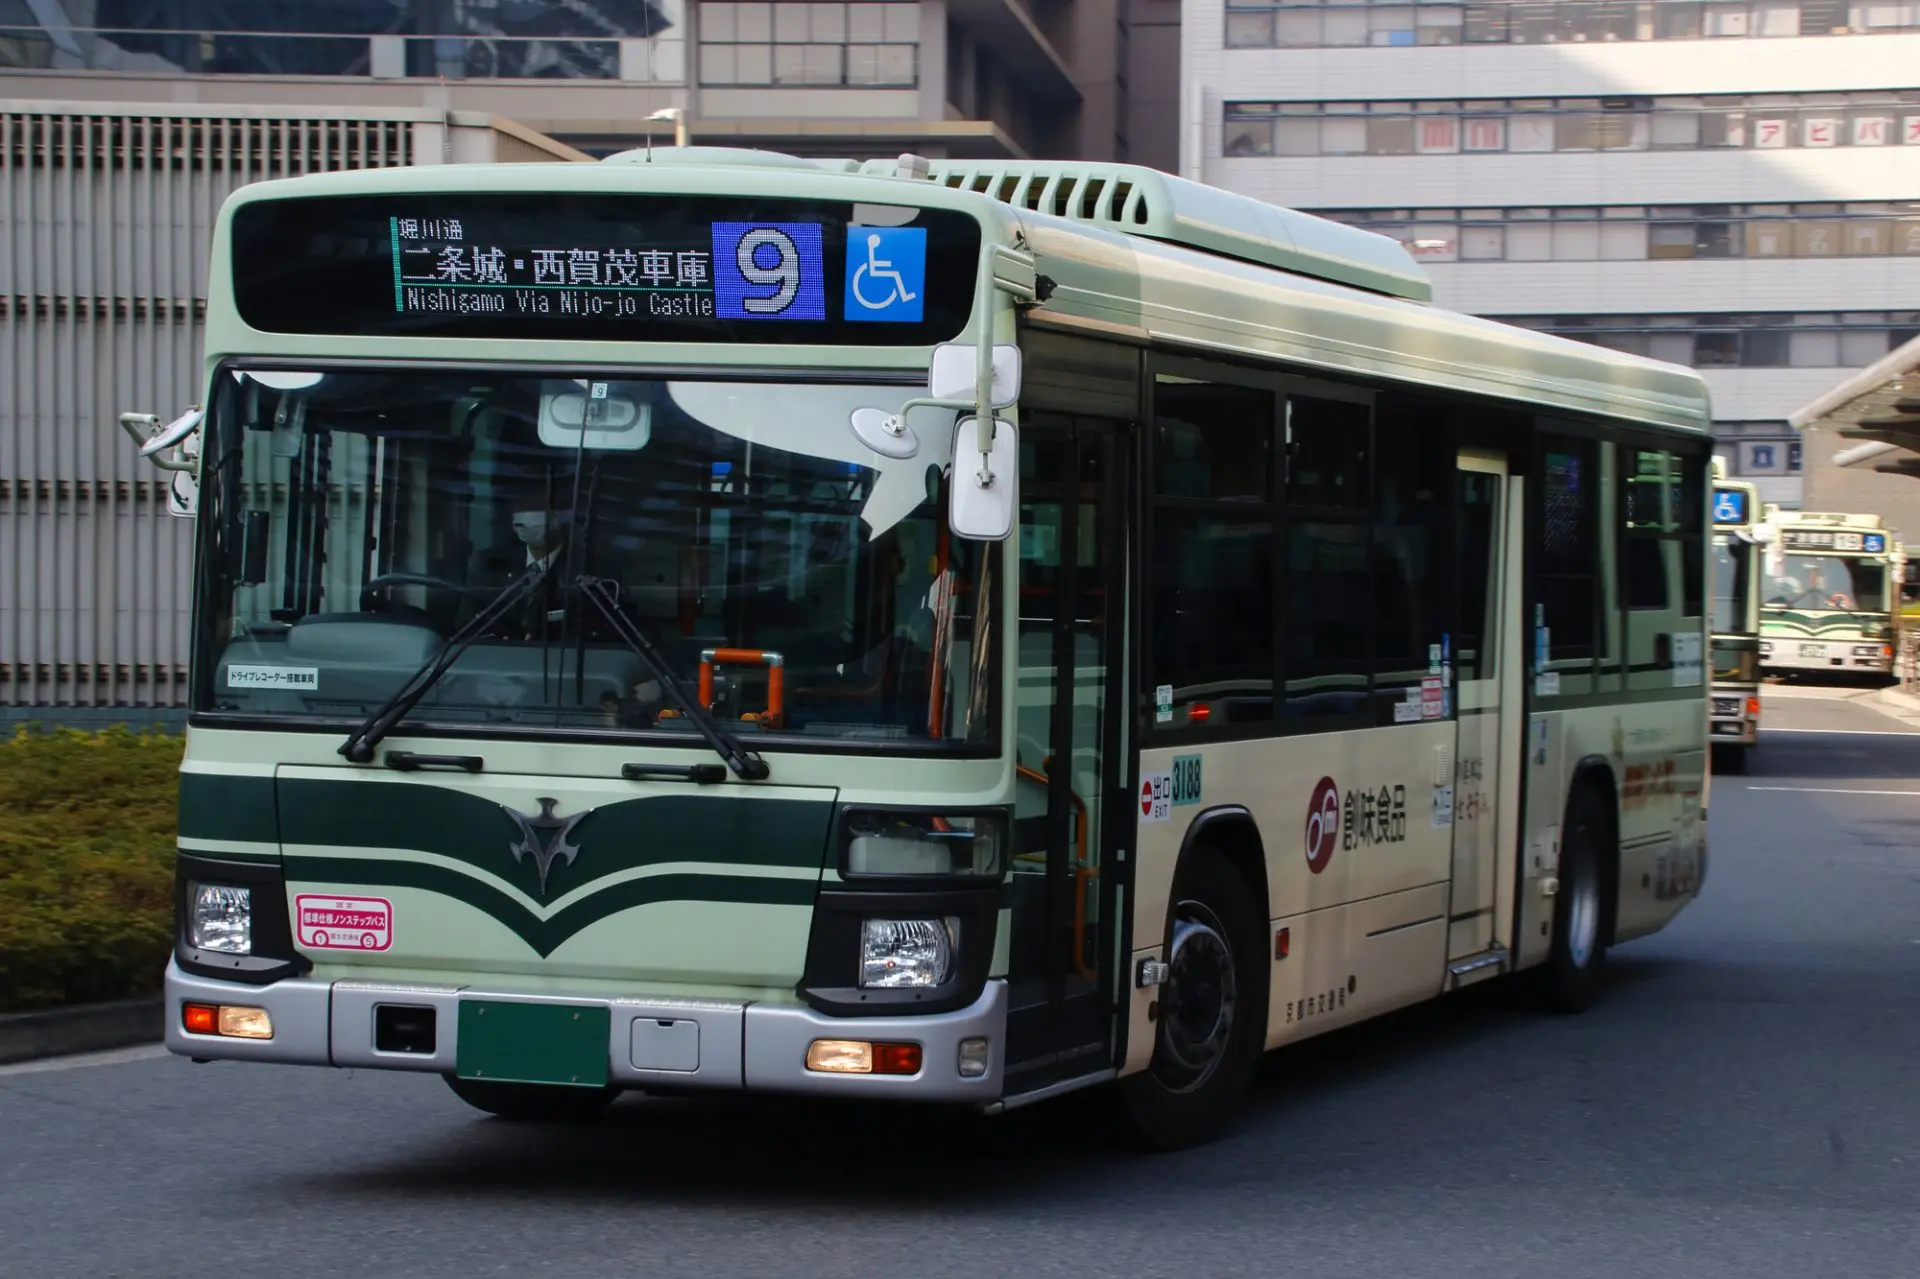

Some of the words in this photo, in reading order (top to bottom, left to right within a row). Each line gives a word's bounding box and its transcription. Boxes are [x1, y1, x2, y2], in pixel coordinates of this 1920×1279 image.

[399, 219, 463, 241] 堀川通
[402, 245, 710, 287] 二条城・西賀茂車庫
[736, 227, 800, 315] 9
[407, 288, 506, 313] Nishigamo
[516, 290, 549, 314] Via
[560, 291, 637, 316] Nijo-jo
[648, 291, 713, 317] Castle
[1153, 775, 1171, 801] 出口
[1172, 758, 1202, 802] 3188
[1155, 803, 1169, 819] EXIT
[1343, 783, 1406, 851] 創味食品
[303, 911, 386, 928] 標準仕様ノンステップバス
